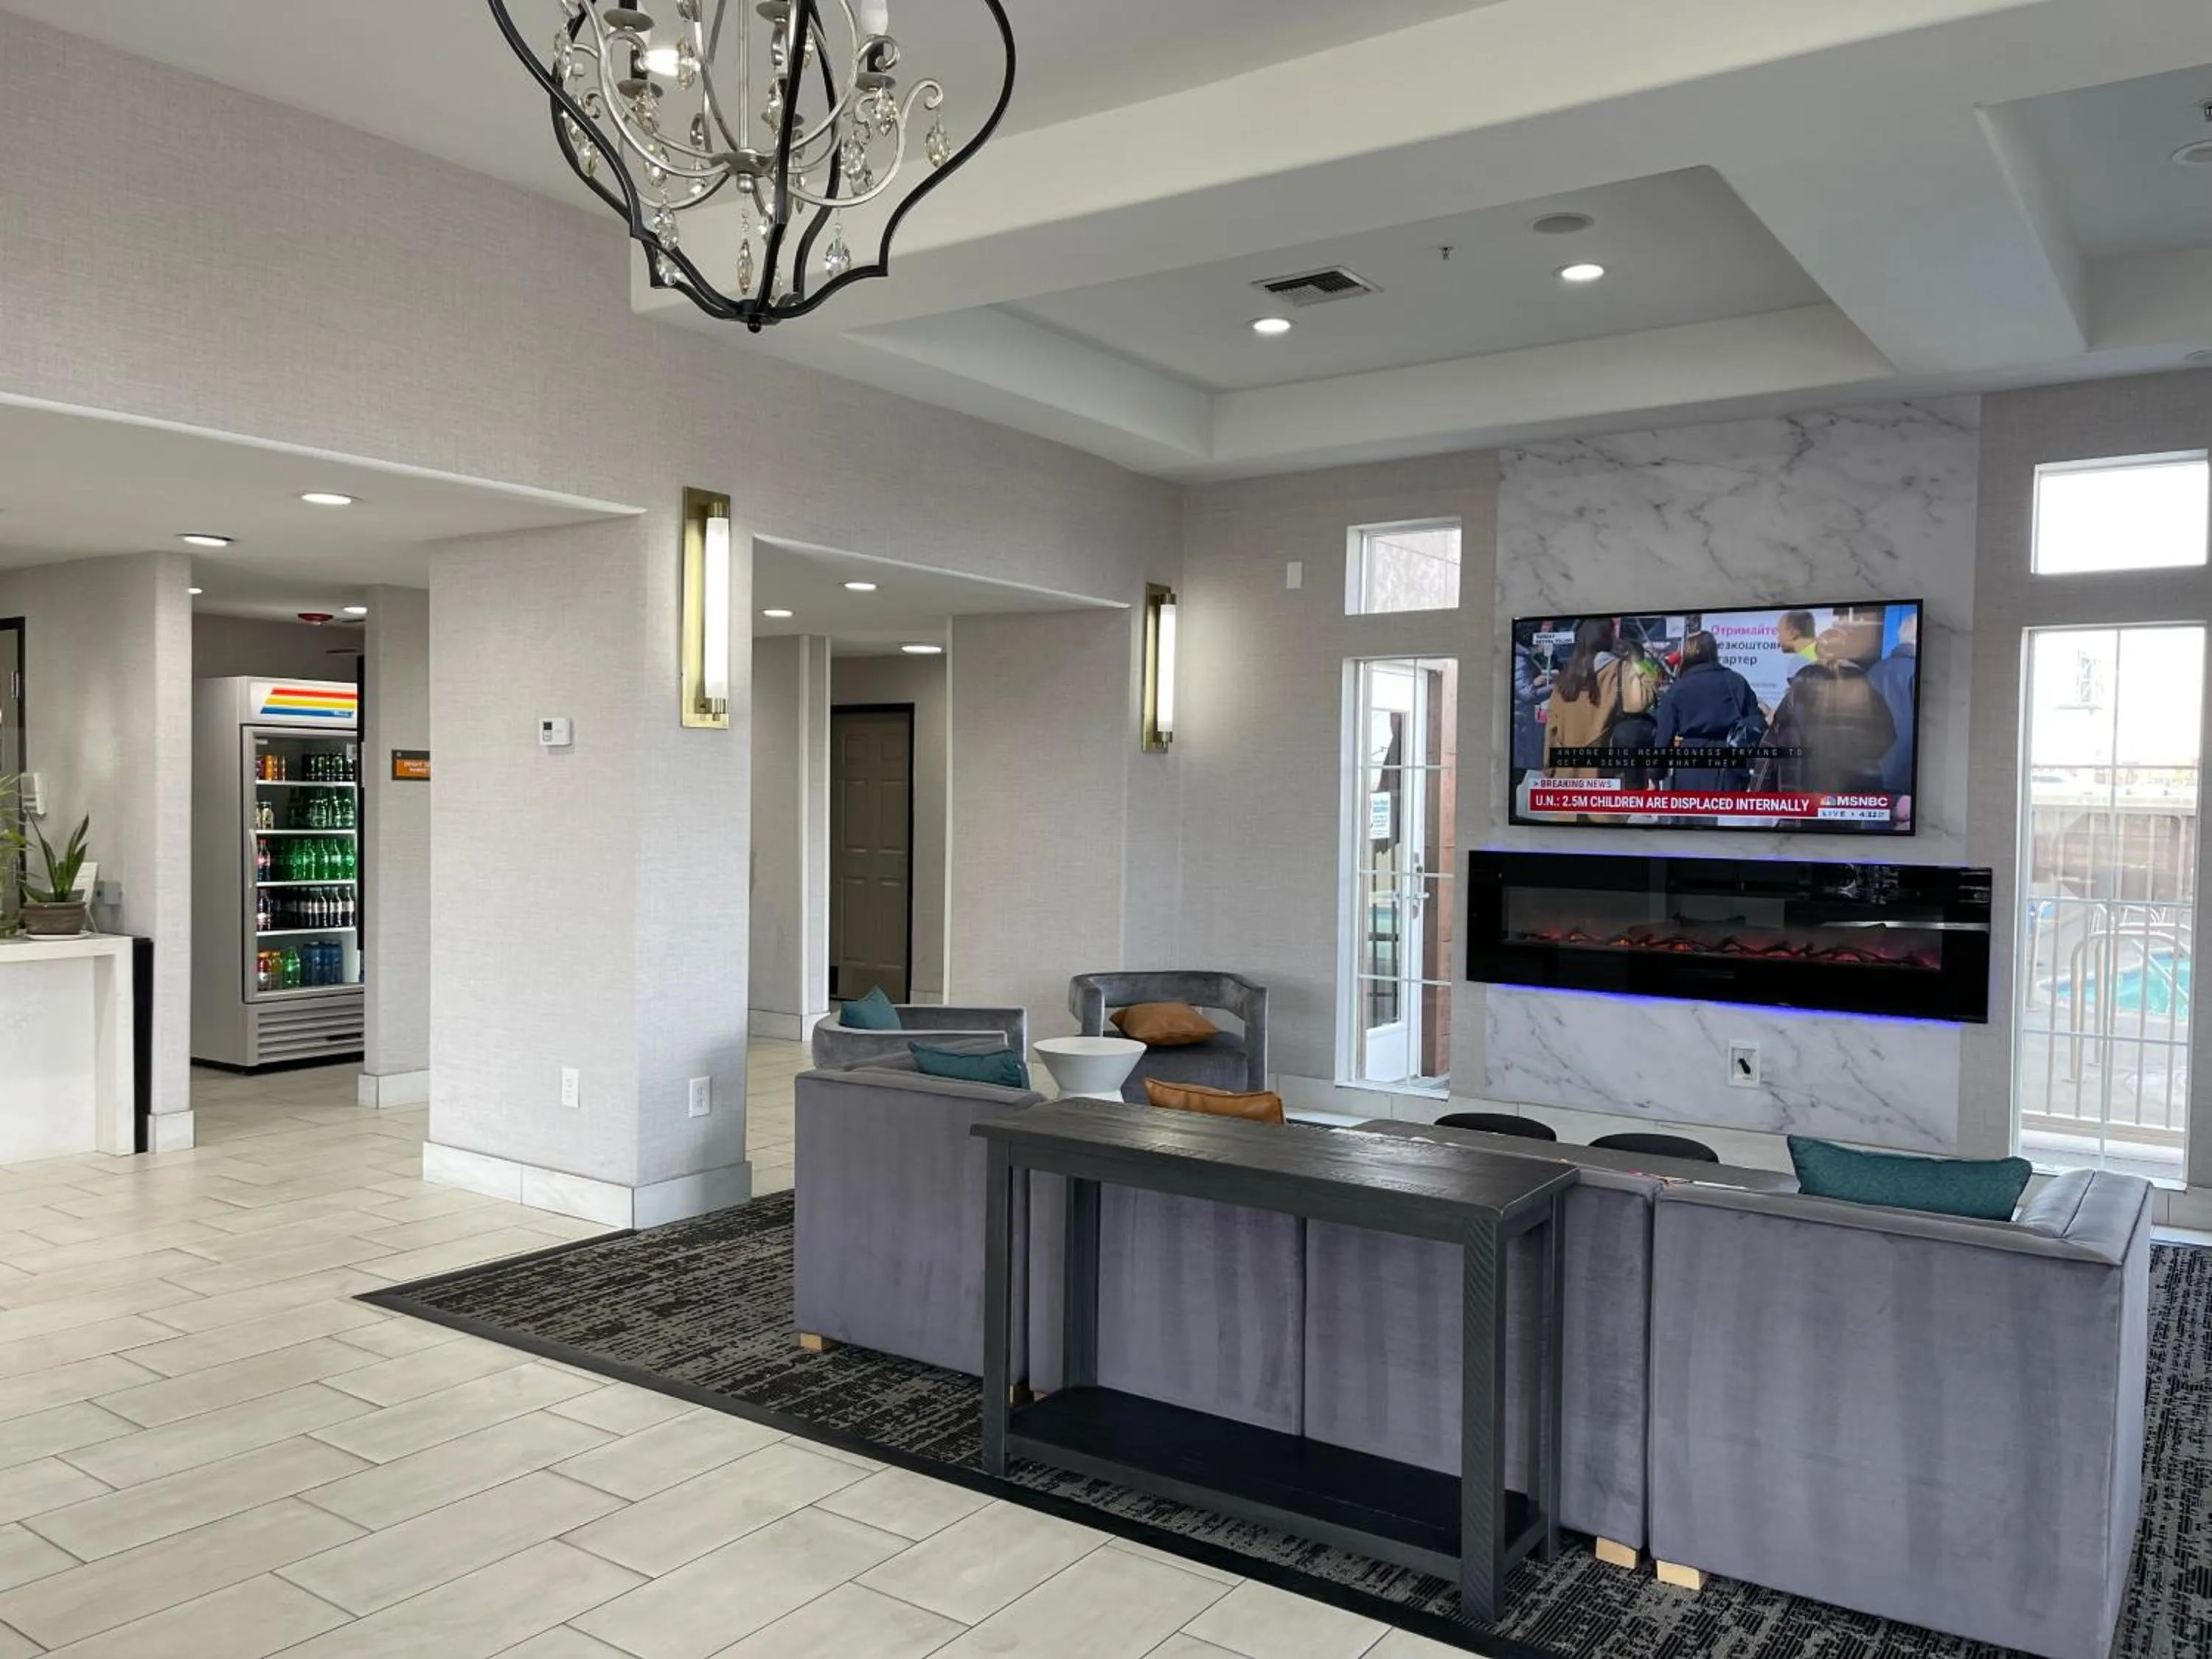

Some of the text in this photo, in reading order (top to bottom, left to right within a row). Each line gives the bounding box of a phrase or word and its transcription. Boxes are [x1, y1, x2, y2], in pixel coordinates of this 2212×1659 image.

[1540, 779, 1613, 788] BREAKING NEWS
[1536, 795, 1809, 812] U.N.: 2.5M CHILDREN ARE DISPLACED INTERNALLY
[1837, 796, 1888, 807] MSNBC
